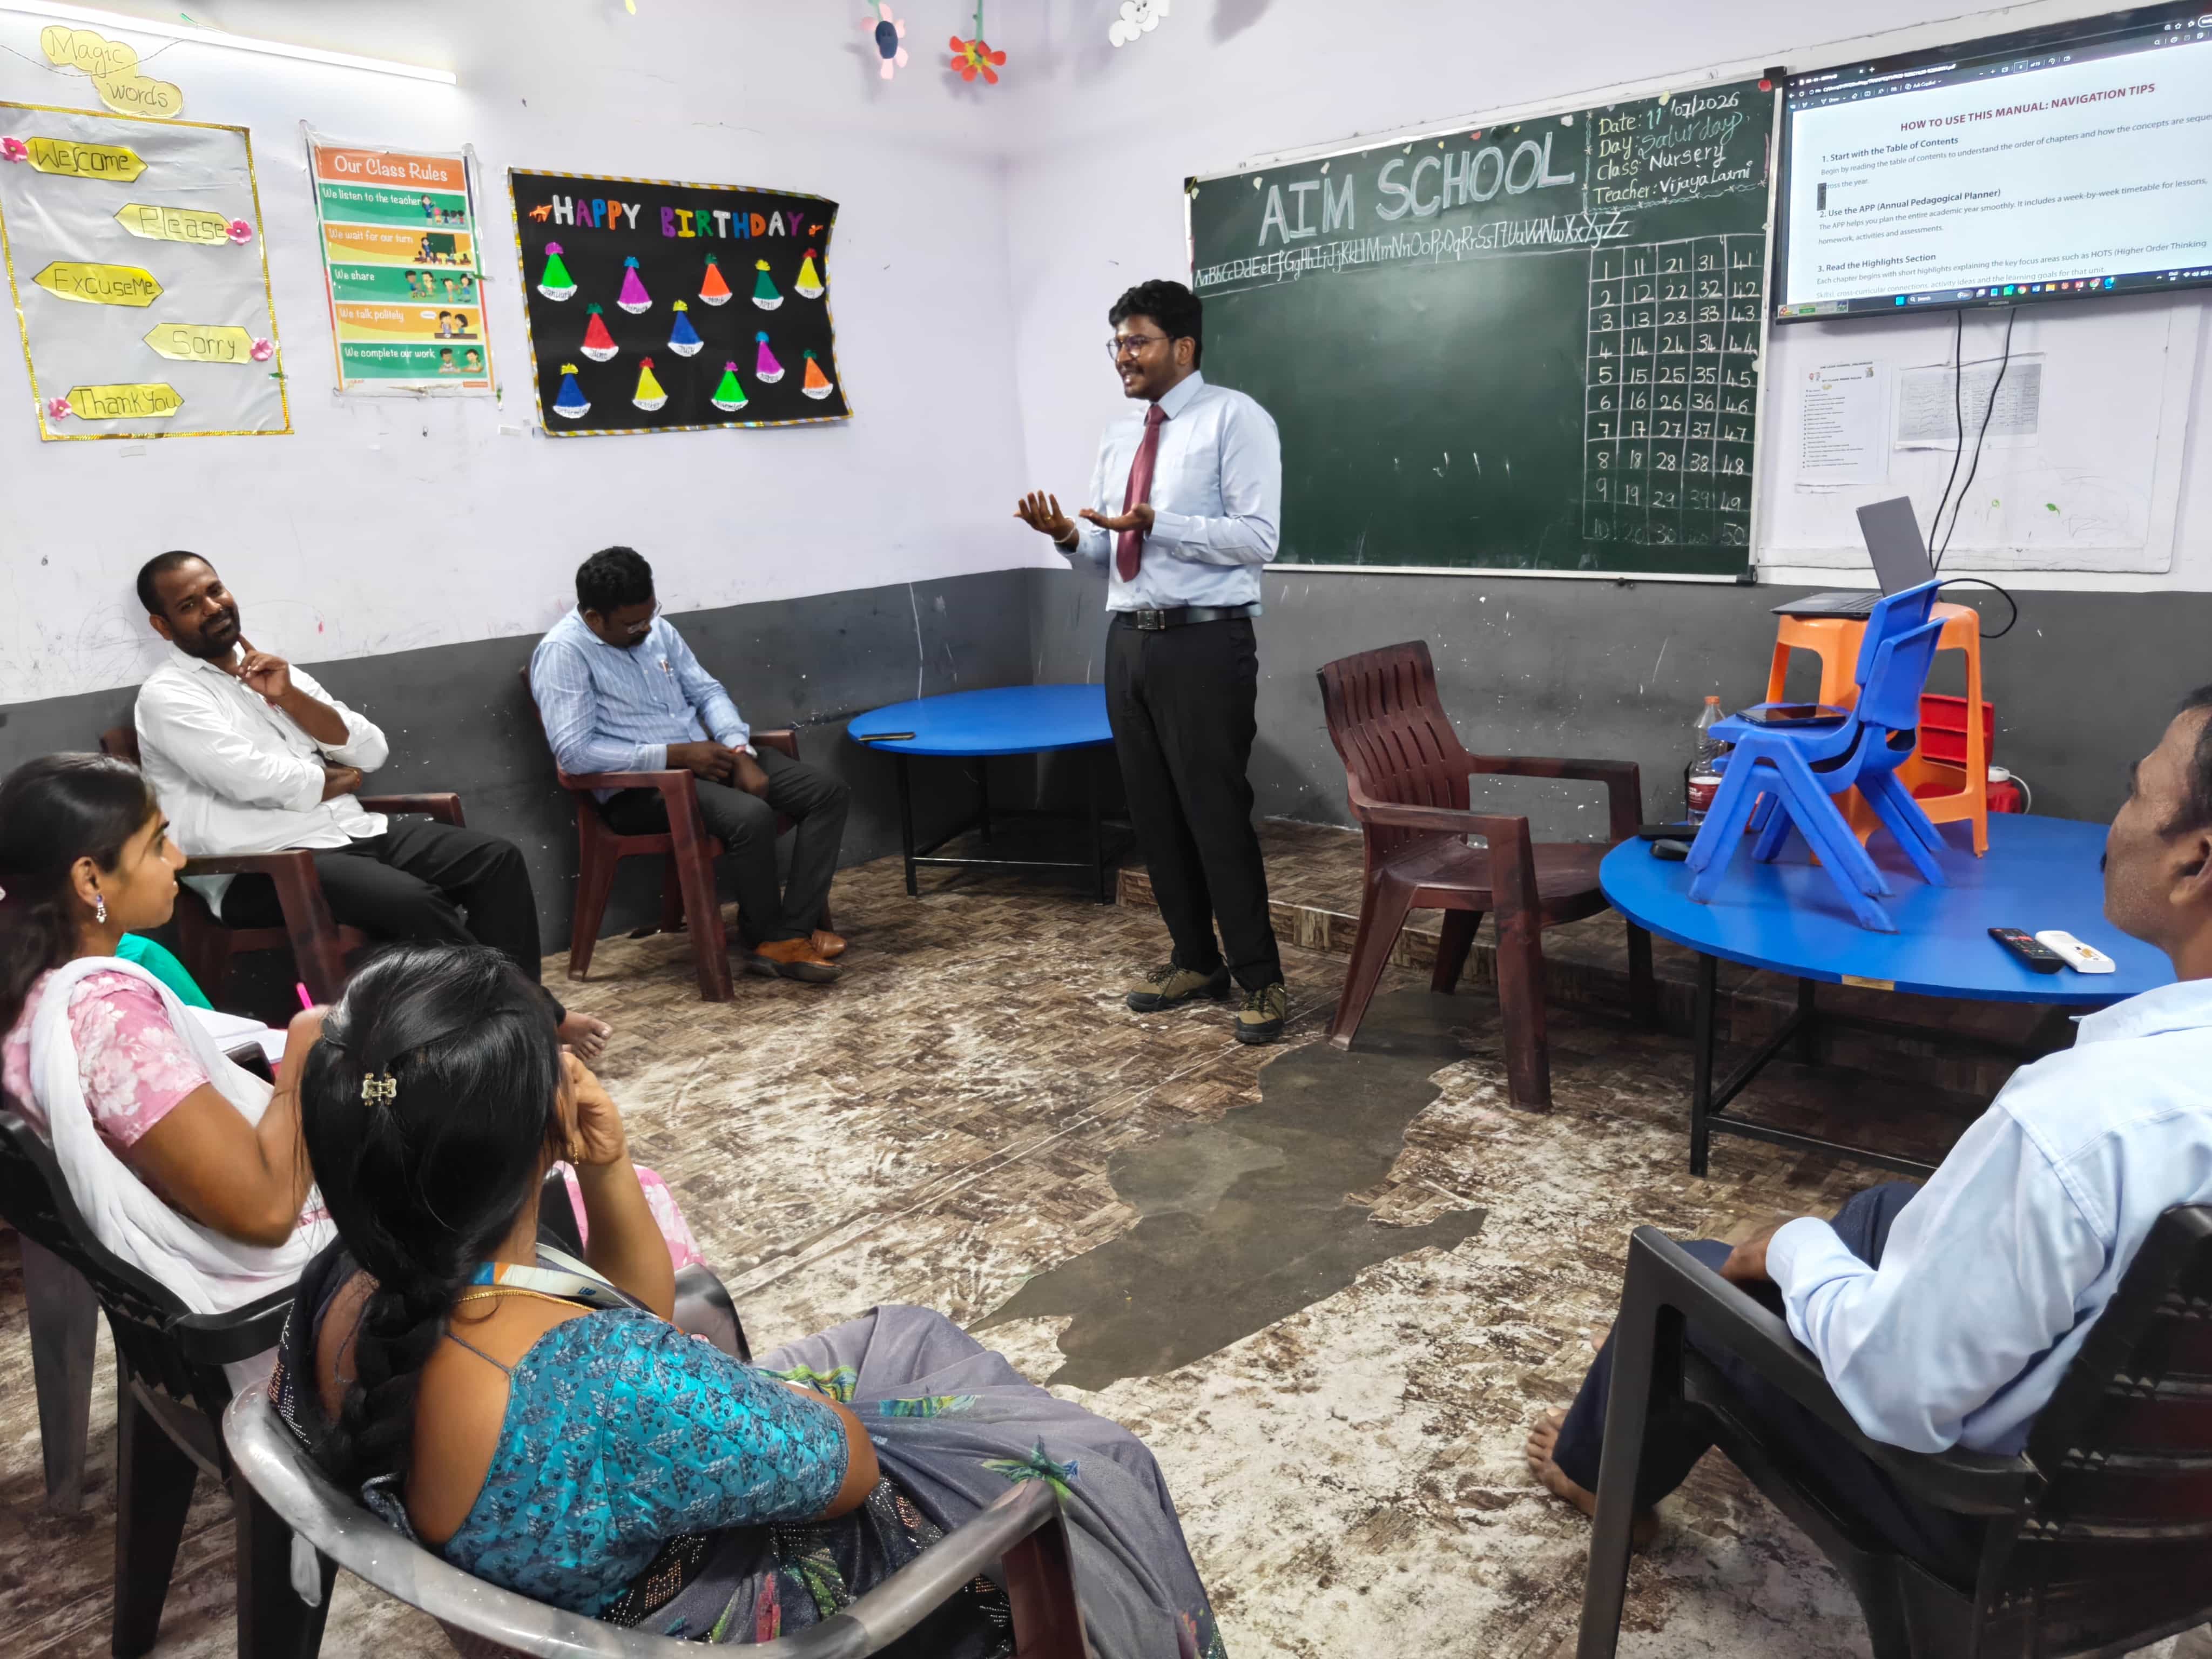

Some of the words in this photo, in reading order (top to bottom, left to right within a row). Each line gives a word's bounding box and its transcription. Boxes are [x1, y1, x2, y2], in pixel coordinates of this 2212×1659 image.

[49, 30, 124, 78] Magic
[1901, 120, 1926, 132] HOW
[1928, 117, 1943, 127] TO
[1946, 114, 1966, 125] USE
[1968, 110, 1992, 122] THIS
[1995, 102, 2048, 118] MANUAL:
[2052, 88, 2126, 109] NAVIGATION
[2129, 83, 2155, 96] TIPS
[1599, 115, 1642, 135] Date:
[1649, 145, 1726, 171] Nursery
[1831, 152, 1849, 161] Start
[1851, 149, 1869, 158] with
[1871, 147, 1884, 156] the
[1886, 143, 1907, 153] Table
[1910, 140, 1918, 150] of
[1920, 138, 1958, 148] Contents
[1850, 163, 1875, 171] reading
[1890, 157, 1906, 166] table
[1908, 155, 1916, 163] of
[1917, 152, 1946, 162] contents
[1958, 144, 1999, 157] understand
[2014, 140, 2035, 149] order
[2036, 137, 2045, 145] of
[2046, 133, 2078, 144] chapters
[2080, 129, 2095, 139] and
[2117, 125, 2130, 133] the
[2132, 120, 2169, 131] concepts
[334, 156, 362, 172] Our
[367, 158, 405, 178] Class
[409, 163, 448, 181] Rules
[323, 188, 337, 199] We
[339, 189, 363, 201] listen
[365, 192, 374, 202] to
[376, 192, 389, 203] the
[390, 194, 421, 205] teacher
[1258, 174, 1354, 247] AIM
[1376, 132, 1574, 220] SCHOOL
[1845, 207, 1857, 215] the
[1859, 204, 1875, 213] APP
[1878, 199, 1908, 211] (Annual
[1911, 192, 1962, 206] Pedagogical
[1965, 188, 2000, 199] Planner)
[1879, 215, 1893, 225] plan
[1908, 211, 1927, 220] entire
[1929, 207, 1963, 217] academic
[2025, 197, 2055, 206] includes
[2122, 183, 2160, 194] timetable
[139, 207, 226, 240] Please
[552, 195, 641, 230] HAPPY
[660, 206, 804, 239] BIRTHDAY
[328, 228, 343, 238] We
[345, 231, 363, 240] wait
[366, 230, 377, 241] for
[381, 234, 394, 242] our
[334, 269, 348, 280] We
[351, 269, 375, 281] share
[1635, 258, 1644, 276] 11
[1665, 258, 1683, 272] 21
[1698, 255, 1713, 271] 31
[1735, 251, 1751, 269] 41
[1826, 262, 1845, 271] Read
[1847, 261, 1860, 269] the
[1862, 257, 1903, 268] Highlights
[1906, 254, 1936, 264] Section
[1601, 290, 1615, 307] 2
[1633, 285, 1654, 303] 12
[1665, 285, 1688, 299] 22
[1699, 281, 1723, 298] 32
[1734, 281, 1760, 299] 42
[340, 307, 353, 318] We
[356, 309, 372, 320] talk
[374, 308, 404, 323] politely
[1601, 313, 1613, 331] 3
[1633, 312, 1649, 328] 13
[1664, 311, 1687, 325] 23
[1698, 306, 1719, 321] 33
[1732, 306, 1755, 322] 43
[172, 331, 235, 360] Sorry
[345, 347, 359, 358] We
[361, 348, 398, 362] complete
[401, 350, 412, 358] our
[415, 349, 435, 359] work
[1600, 341, 1612, 359] 4
[1631, 337, 1648, 356] 14
[1663, 335, 1684, 353] 24
[1697, 334, 1716, 352] 34
[1729, 333, 1757, 354] 44
[1599, 367, 1612, 383] 5
[1631, 367, 1648, 383] 15
[1660, 367, 1685, 383] 25
[1694, 367, 1716, 383] 35
[1727, 369, 1751, 387] 45
[1600, 395, 1610, 410] 6
[1630, 391, 1645, 410] 16
[1660, 395, 1682, 411] 26
[1692, 394, 1714, 410] 36
[1725, 396, 1749, 414] 46
[1599, 423, 1609, 439] 7
[1632, 421, 1646, 437] 17
[1660, 421, 1681, 437] 27
[1692, 422, 1711, 439] 37
[1724, 425, 1746, 441] 47
[1598, 452, 1609, 469] 8
[1630, 450, 1642, 469] 18
[1656, 452, 1675, 471] 28
[1690, 454, 1708, 472] 38
[1722, 455, 1744, 475] 48
[1596, 477, 1607, 502] 9
[1626, 484, 1638, 505] 19
[1653, 491, 1674, 508] 29
[1721, 492, 1741, 512] 49
